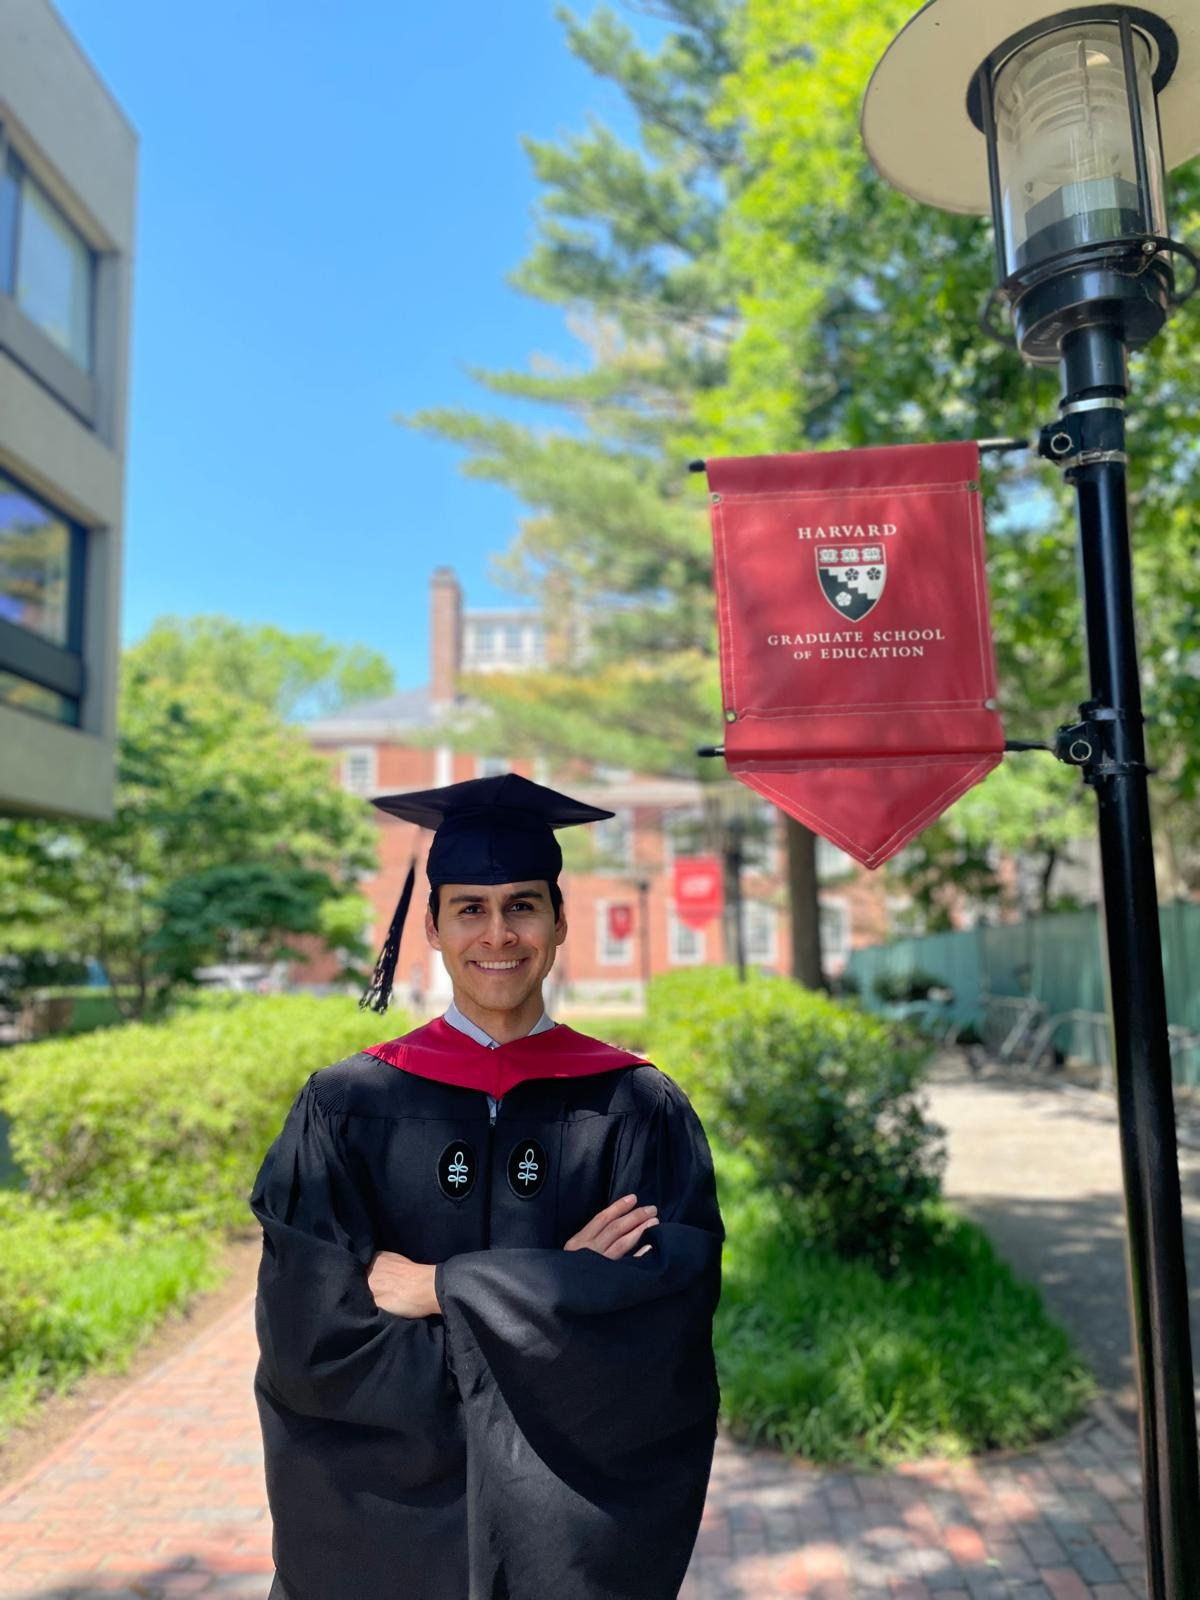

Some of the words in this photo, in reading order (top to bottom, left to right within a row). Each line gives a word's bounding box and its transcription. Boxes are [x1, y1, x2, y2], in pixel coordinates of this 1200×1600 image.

[797, 524, 897, 539] HARVARD
[767, 631, 864, 646] GRADUATE
[873, 629, 945, 642] SCHOOL
[793, 651, 812, 660] OF
[821, 646, 924, 659] EDUCATION
